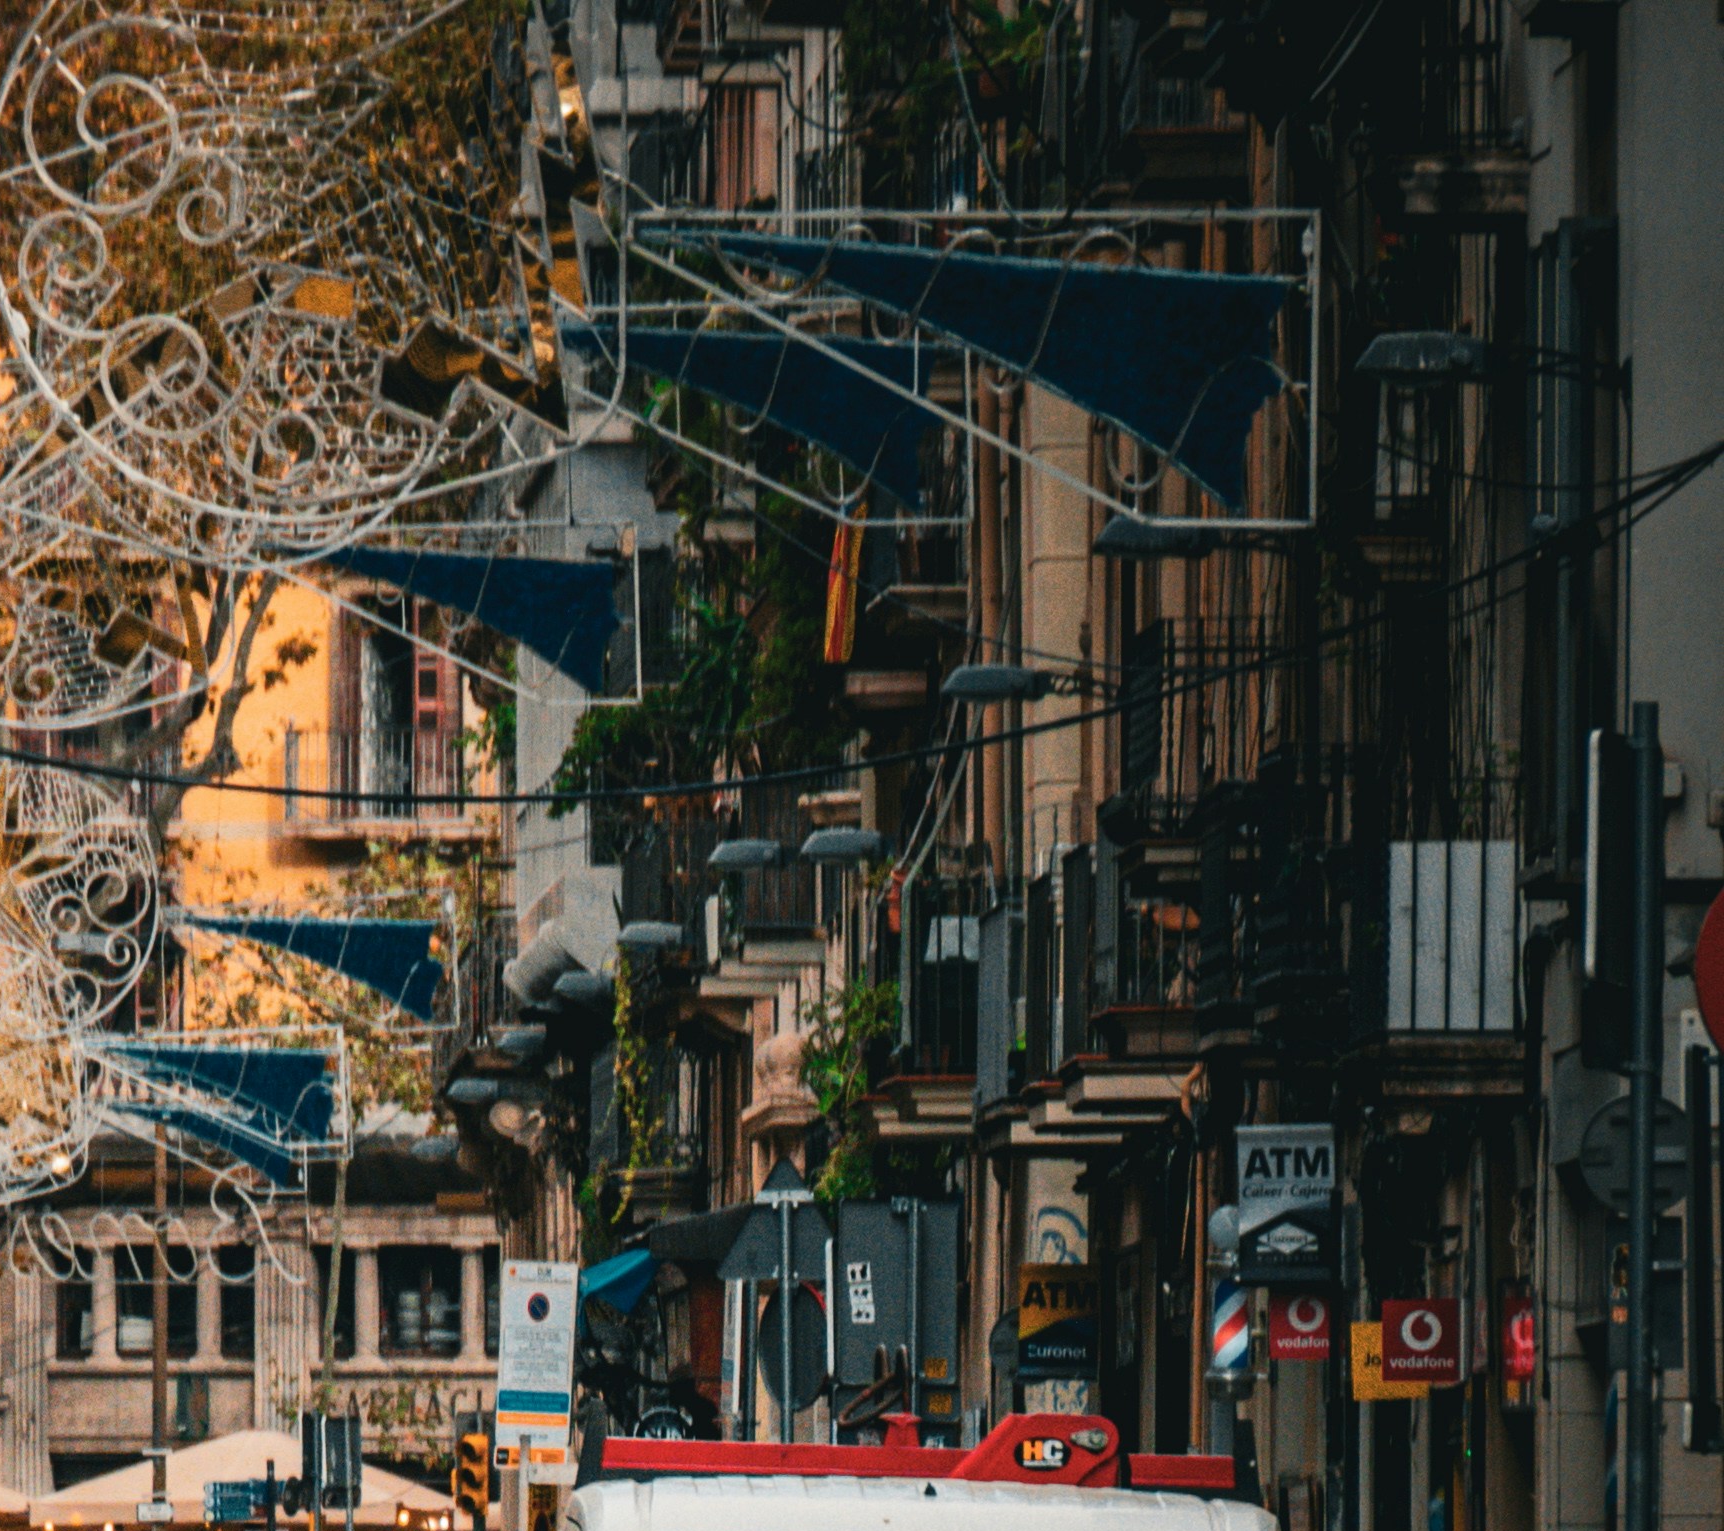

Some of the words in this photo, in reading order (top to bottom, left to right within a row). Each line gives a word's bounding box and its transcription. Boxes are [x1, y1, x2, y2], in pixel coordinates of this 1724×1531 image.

[1244, 1147, 1330, 1178] ATM
[1022, 1281, 1097, 1310] ATM
[1027, 1344, 1087, 1359] Euronet
[1389, 1354, 1455, 1370] vodafone
[1022, 1439, 1064, 1461] HC
